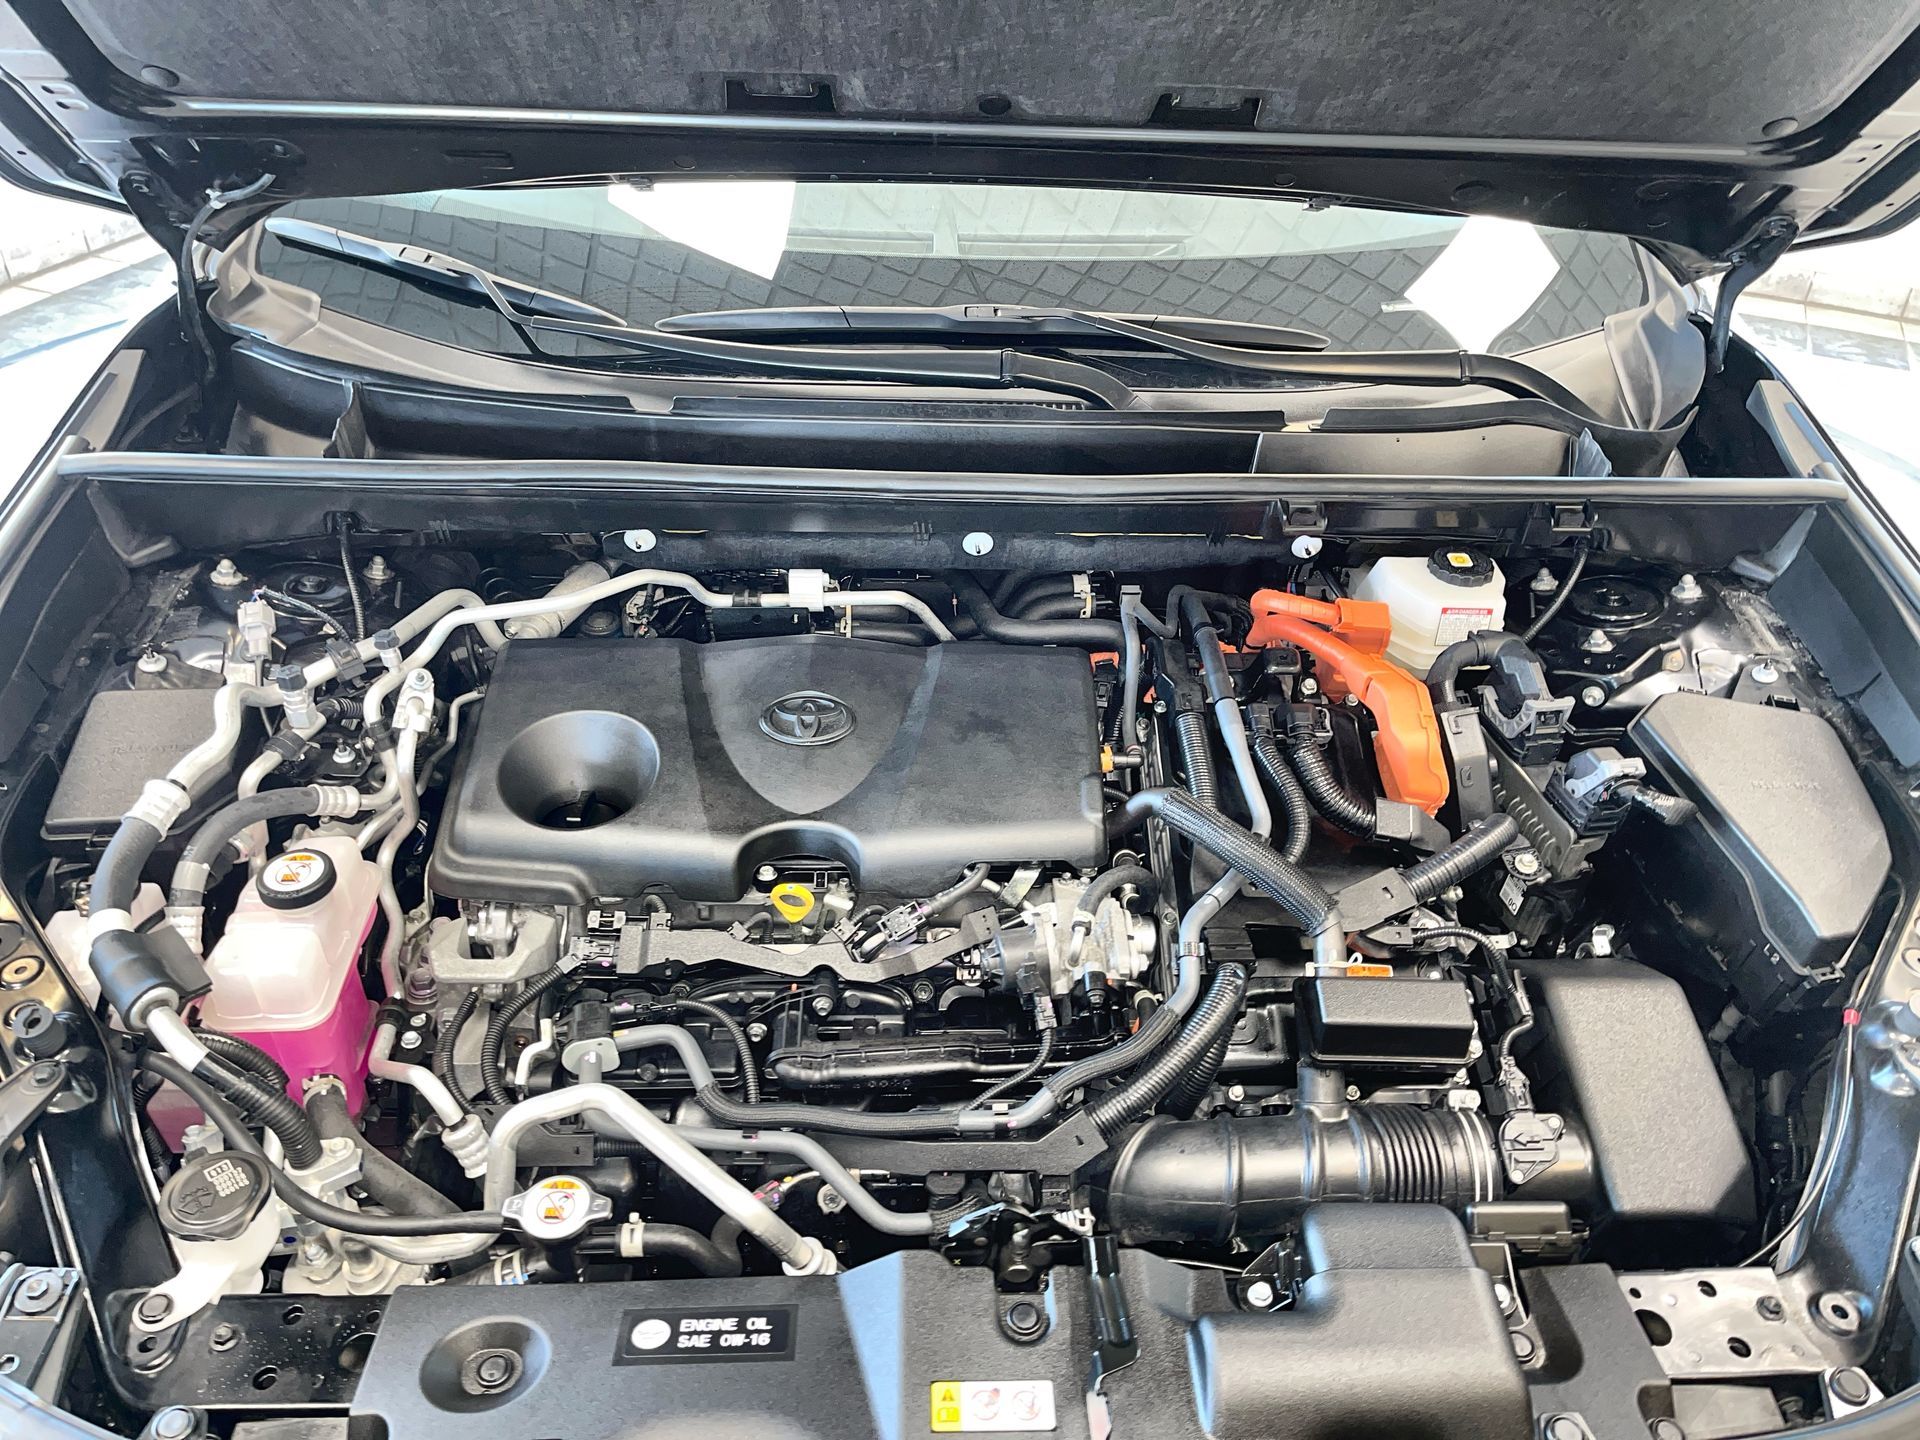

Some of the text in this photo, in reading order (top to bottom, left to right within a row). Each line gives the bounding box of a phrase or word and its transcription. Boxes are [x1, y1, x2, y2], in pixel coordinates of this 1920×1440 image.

[679, 1317, 773, 1332] ENGINE OIL
[677, 1333, 771, 1348] SAE 0W-16
